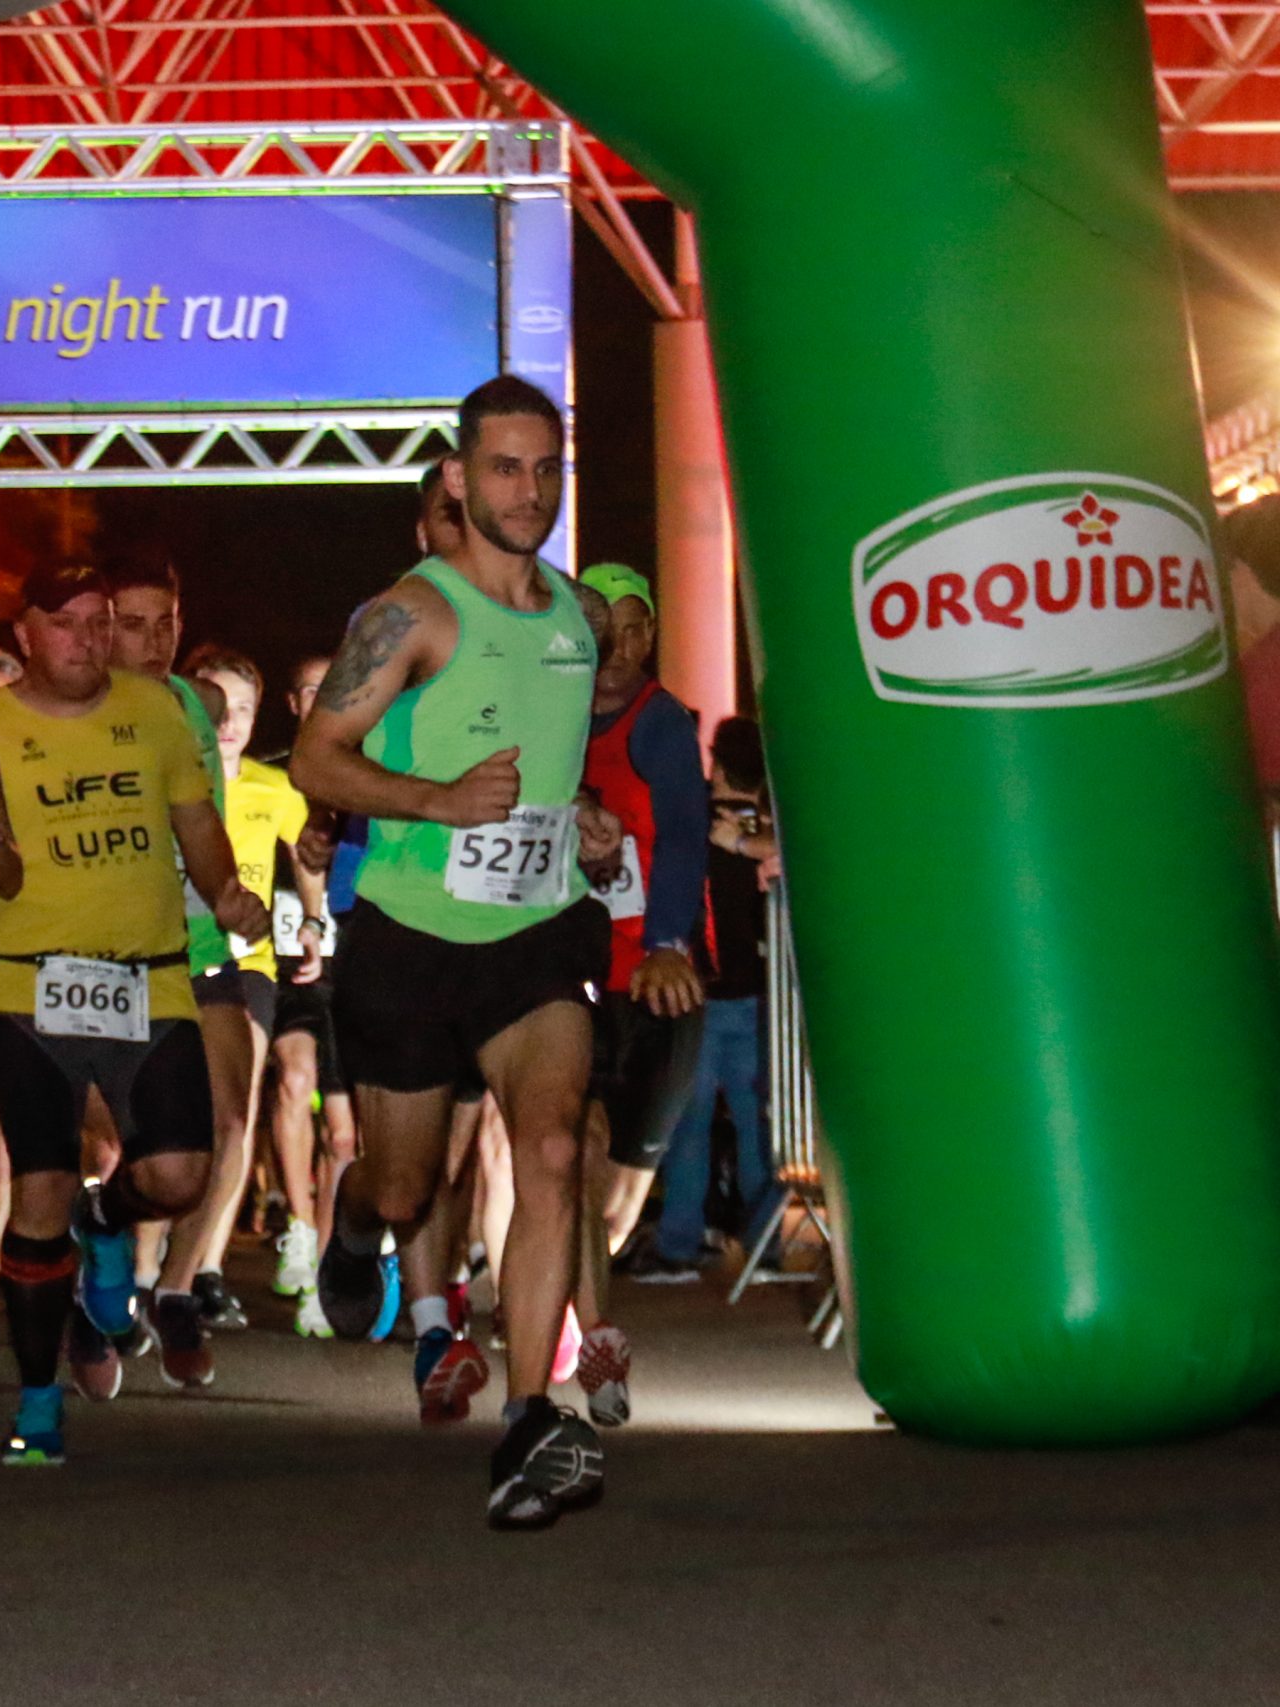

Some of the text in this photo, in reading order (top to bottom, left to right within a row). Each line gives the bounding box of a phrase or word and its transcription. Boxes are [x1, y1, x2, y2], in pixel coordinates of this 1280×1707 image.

[4, 279, 168, 359] night
[181, 293, 287, 341] run
[869, 554, 1216, 640] ORQUIDEA
[47, 826, 150, 867] LUPO
[459, 834, 552, 875] 5273
[44, 982, 130, 1015] 5066
